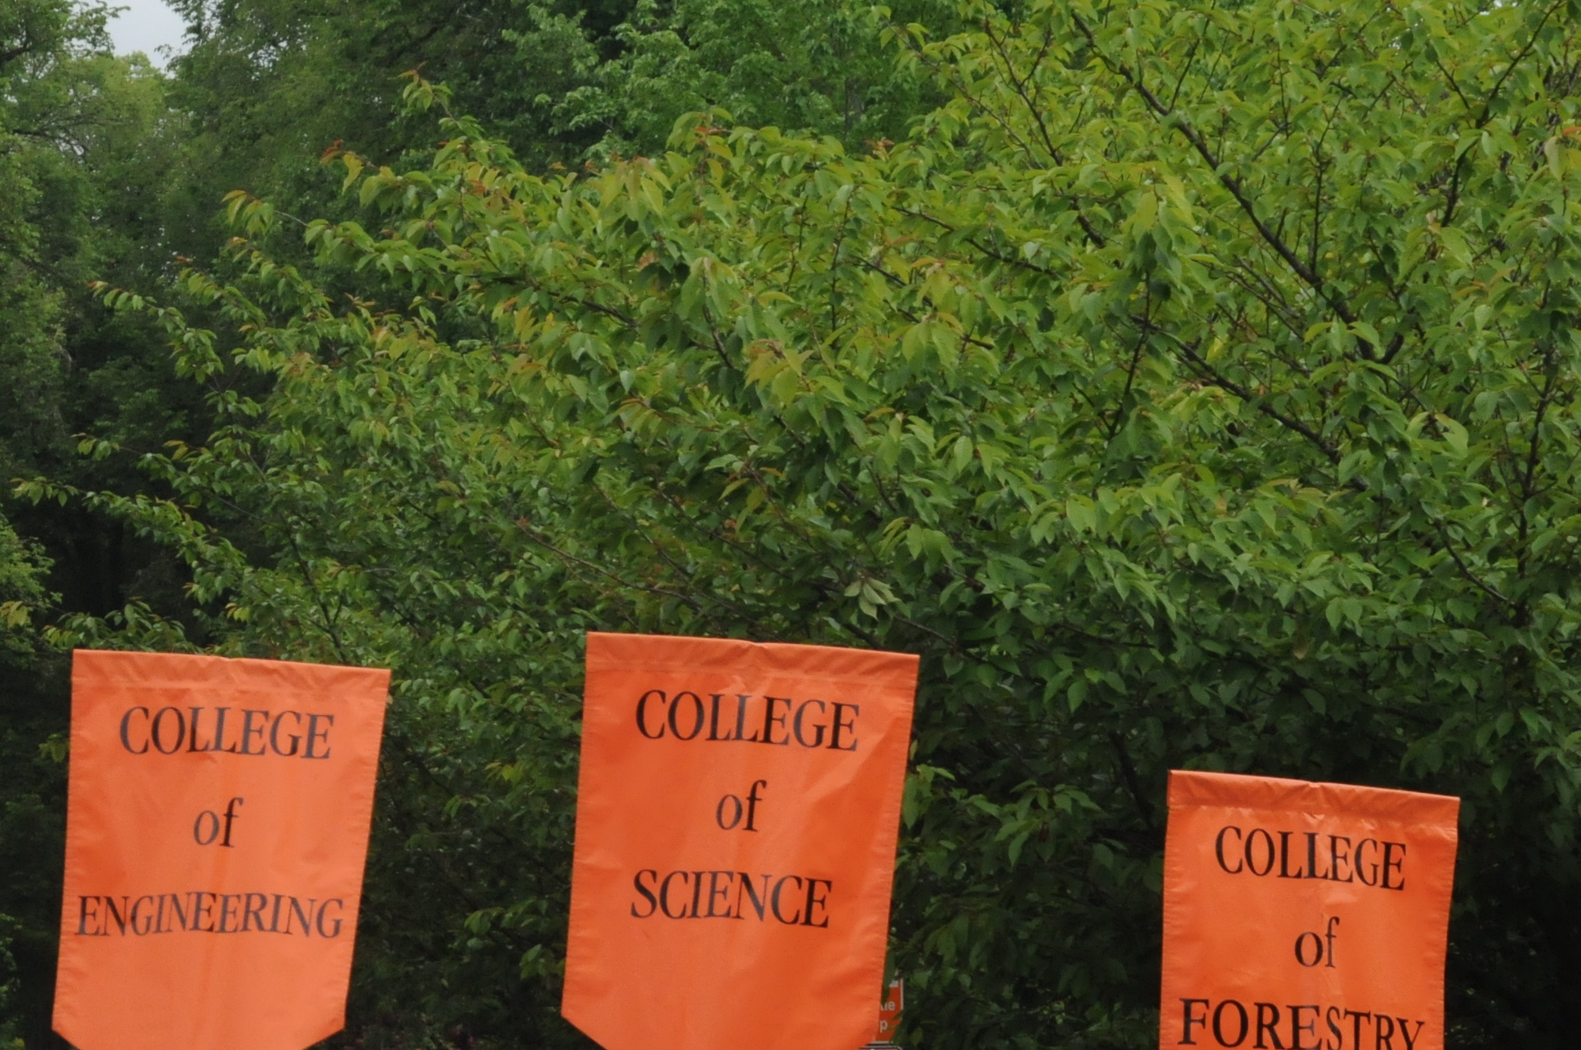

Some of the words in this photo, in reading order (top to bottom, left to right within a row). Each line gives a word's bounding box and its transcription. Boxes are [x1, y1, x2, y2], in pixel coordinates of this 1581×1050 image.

[119, 706, 335, 760] COLLEGE
[635, 689, 860, 752] COLLEGE
[193, 797, 244, 848] of
[716, 779, 767, 832] of
[1214, 825, 1407, 891] COLLEGE
[76, 891, 344, 938] ENGINEERING
[630, 869, 833, 929] SCIENCE
[1294, 916, 1340, 969] of
